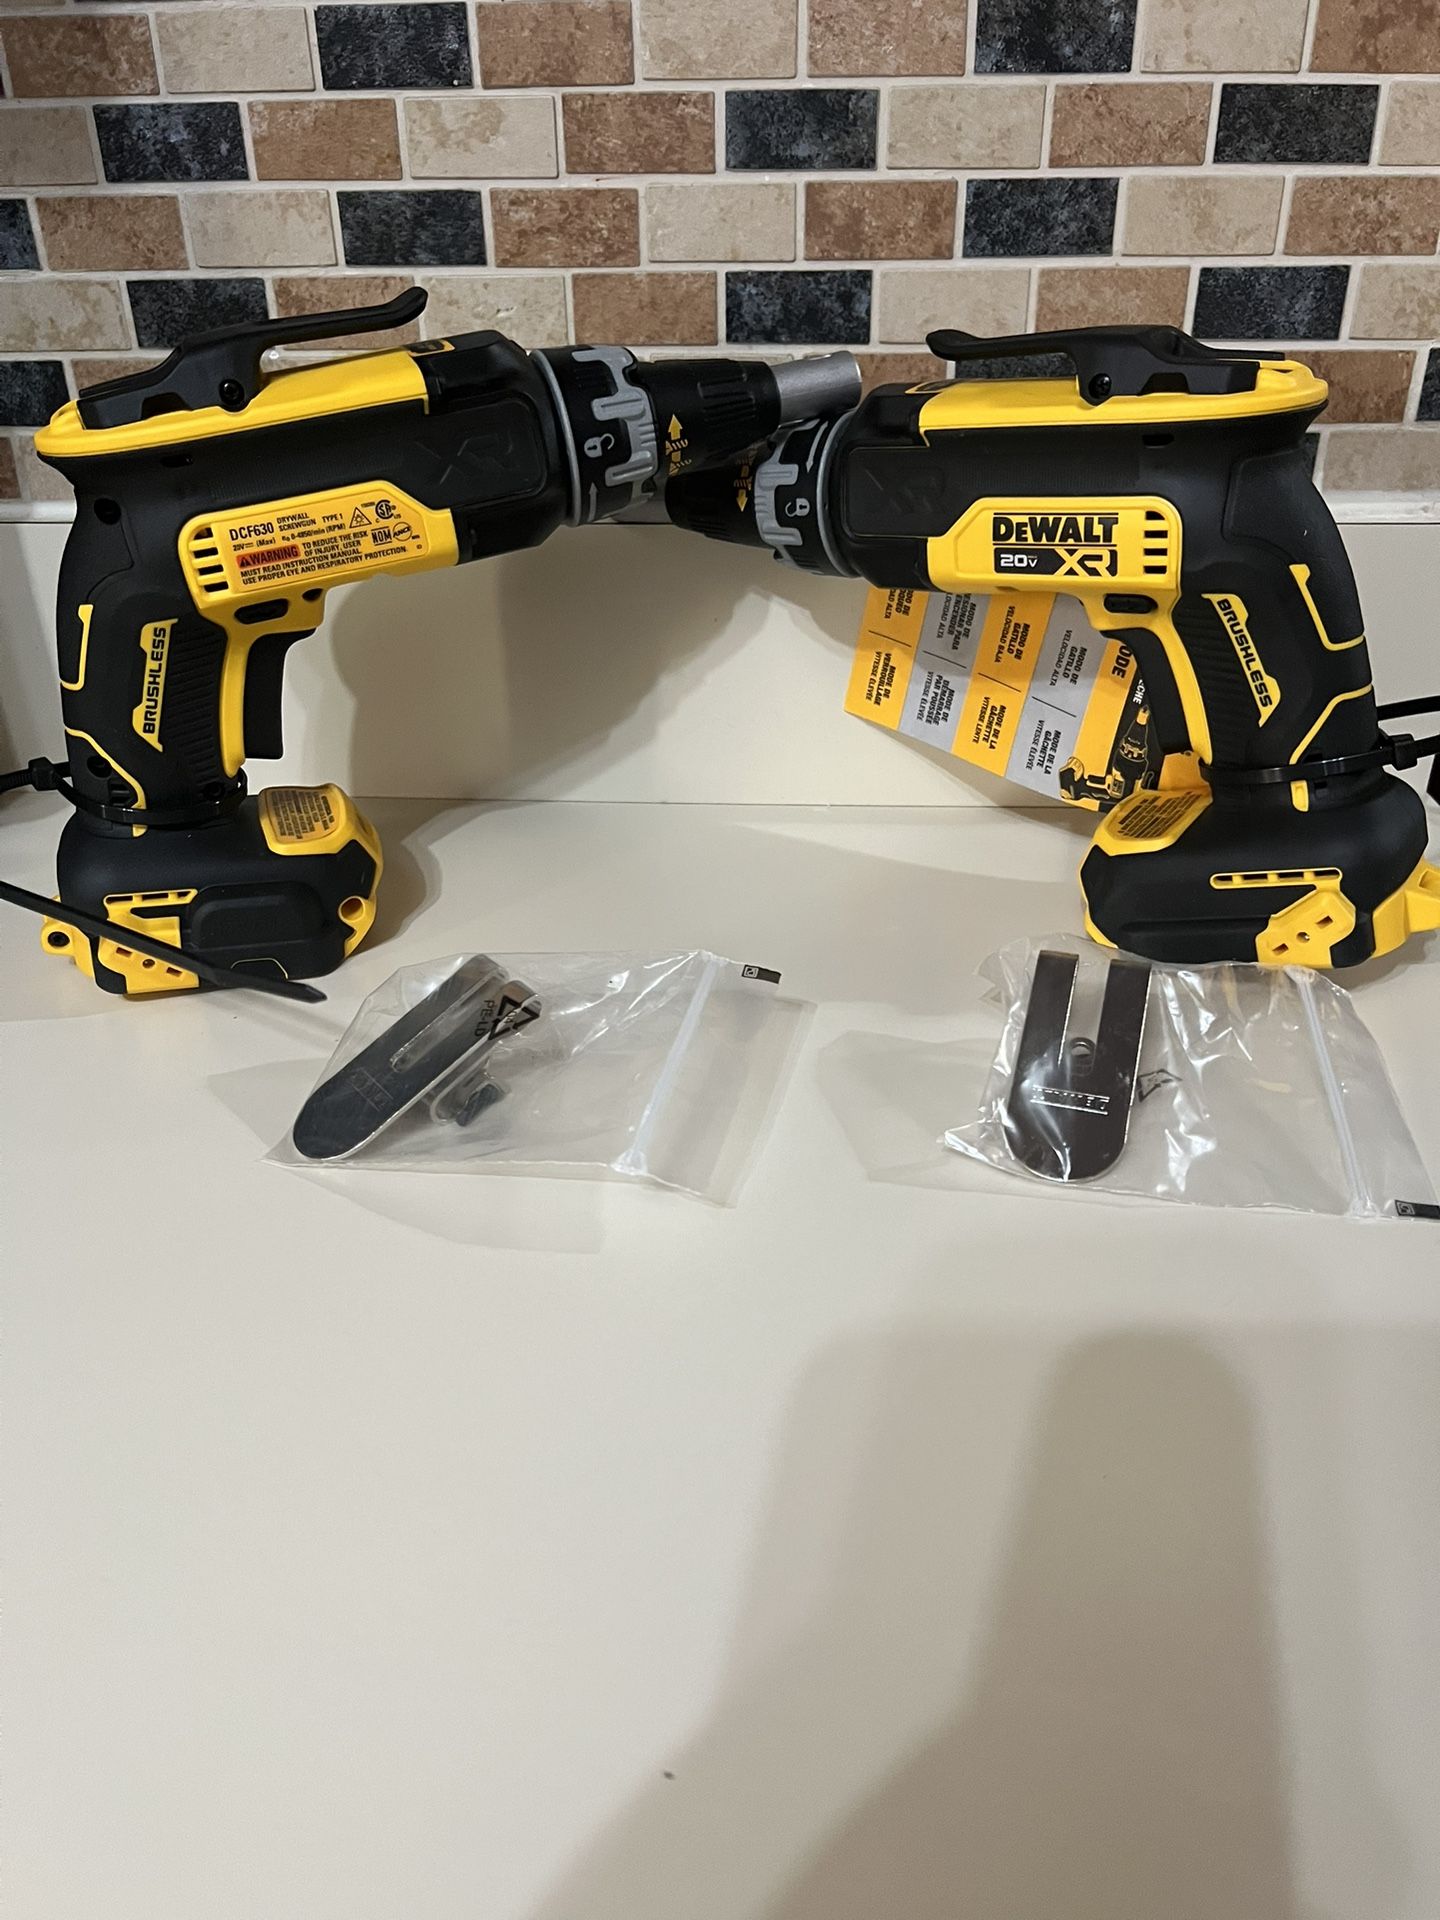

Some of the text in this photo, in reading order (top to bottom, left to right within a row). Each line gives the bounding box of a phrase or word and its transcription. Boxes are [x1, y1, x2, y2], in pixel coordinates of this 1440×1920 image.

[229, 522, 274, 541] DCF630
[277, 512, 309, 524] DRYWALL
[278, 518, 316, 532] SCREWGUN
[322, 513, 338, 523] TYPE
[326, 523, 346, 533] (RPM)
[312, 537, 338, 548] REDUCE
[339, 533, 352, 542] THE
[353, 530, 368, 539] RISK
[343, 539, 362, 549] USER
[371, 528, 393, 544] NOM
[241, 568, 261, 577] MUST
[263, 564, 281, 573] READ
[283, 554, 329, 570] INSTRUCTION
[242, 577, 257, 585] USE
[259, 571, 286, 582] PROPER
[286, 568, 299, 576] EYE
[301, 564, 316, 574] AND
[317, 555, 363, 570] RESPIRATORY
[250, 546, 299, 565] WARNING
[1053, 548, 1117, 578] XR
[884, 603, 893, 619] ALTA
[901, 604, 911, 617] DE
[962, 602, 977, 640] MODO DE
[936, 622, 946, 639] ALTA
[951, 629, 962, 651] PARA
[994, 605, 1016, 663] VELOCIDAD BAJA
[1006, 622, 1021, 655] GATILLO
[1014, 623, 1031, 661] MODO DE
[871, 650, 883, 677] VITESSE
[1049, 629, 1073, 687] VELOCIDAD ALTA
[1062, 645, 1078, 679] GATILLO
[1070, 646, 1087, 685] MODO DE
[1216, 598, 1273, 708] BRUSHLESS
[142, 627, 167, 734] BRUSHLESS
[873, 652, 892, 706] VERROUILLAGE
[882, 665, 897, 699] MODE DE
[922, 671, 934, 698] VITESSE
[933, 674, 944, 690] PAR
[941, 688, 956, 723] MODE DE
[972, 696, 991, 745] VITESSE LENTE
[988, 704, 1007, 750] MODE DE LA
[1031, 719, 1045, 747] VITESSE
[1036, 730, 1053, 768] GÂCHETTE
[1043, 729, 1062, 775] MODE DE LA
[474, 1000, 496, 1037] PE-LD
